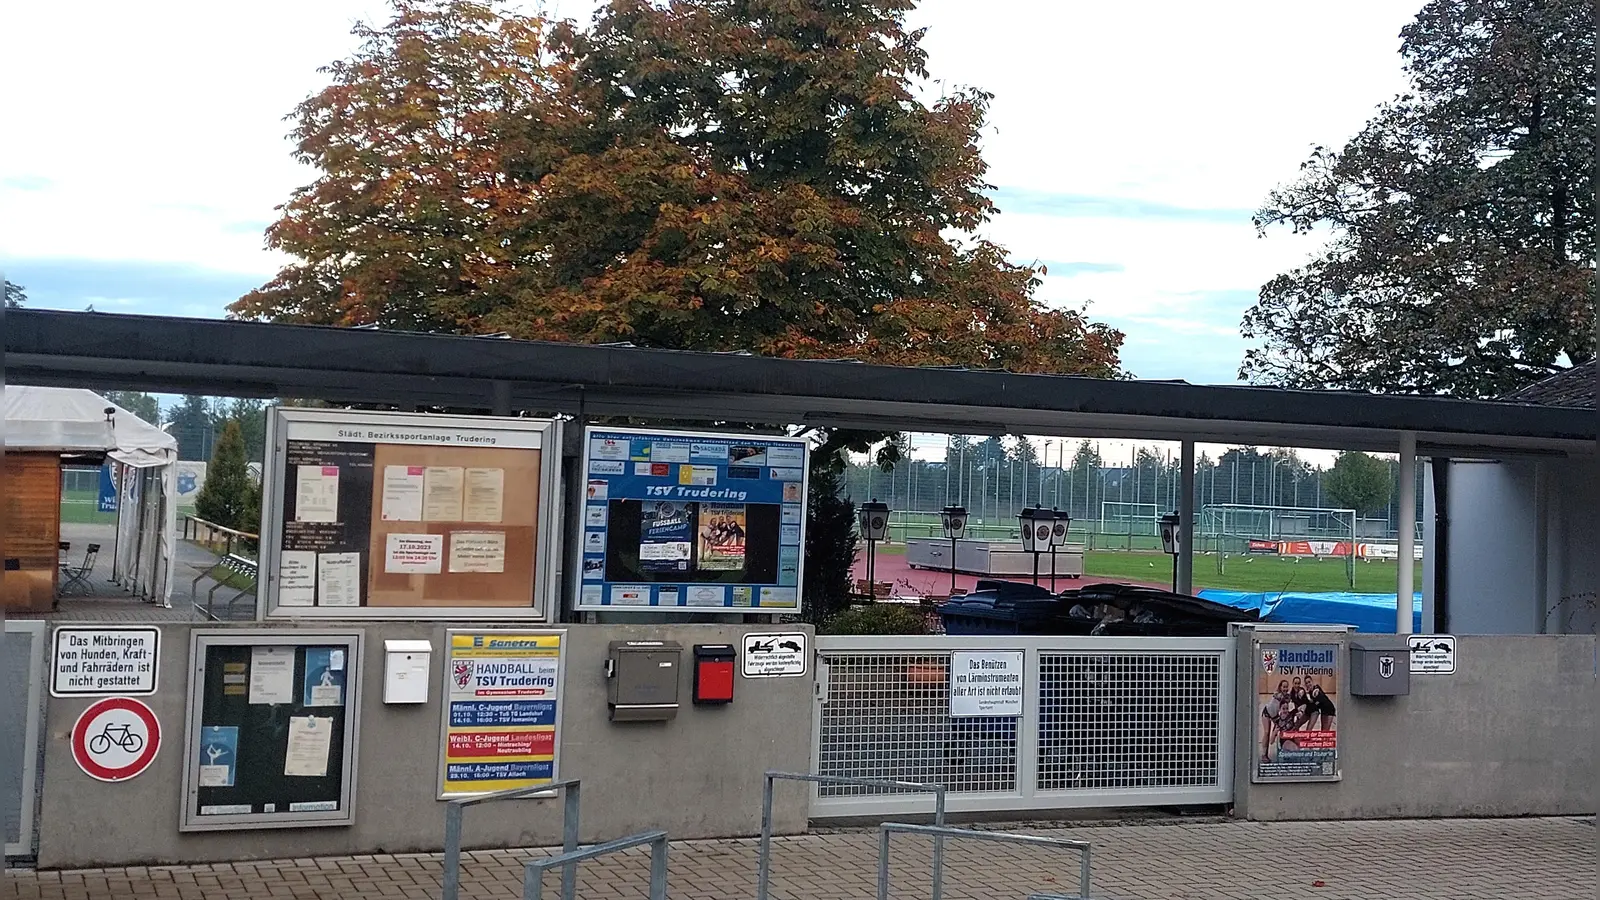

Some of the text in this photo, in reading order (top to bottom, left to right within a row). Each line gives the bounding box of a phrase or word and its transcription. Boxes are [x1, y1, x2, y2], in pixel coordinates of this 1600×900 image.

[338, 430, 496, 444] Städt. Bezirkssportanlage Trudering
[646, 486, 747, 500] TSV Trudering
[653, 518, 681, 527] FUSSBALL
[649, 524, 687, 534] FERIENCAMP
[70, 635, 144, 648] Das Mitbringen
[60, 649, 152, 660] von Hunden, Kraft-
[1279, 650, 1333, 662] Handball
[60, 661, 150, 672] und Fahrrädern ist
[476, 664, 534, 674] HANDBALL
[970, 658, 1007, 669] Das Benützen
[1279, 666, 1333, 677] TSV Trudering
[69, 676, 140, 688] nicht gestattet
[476, 676, 554, 687] TSV Trudering
[968, 673, 1018, 682] Lärminstrumenten
[954, 686, 966, 696] aller
[968, 686, 976, 696] Art
[987, 686, 1000, 696] nicht
[1002, 686, 1021, 696] erlaubt
[479, 704, 512, 712] C-Jugend
